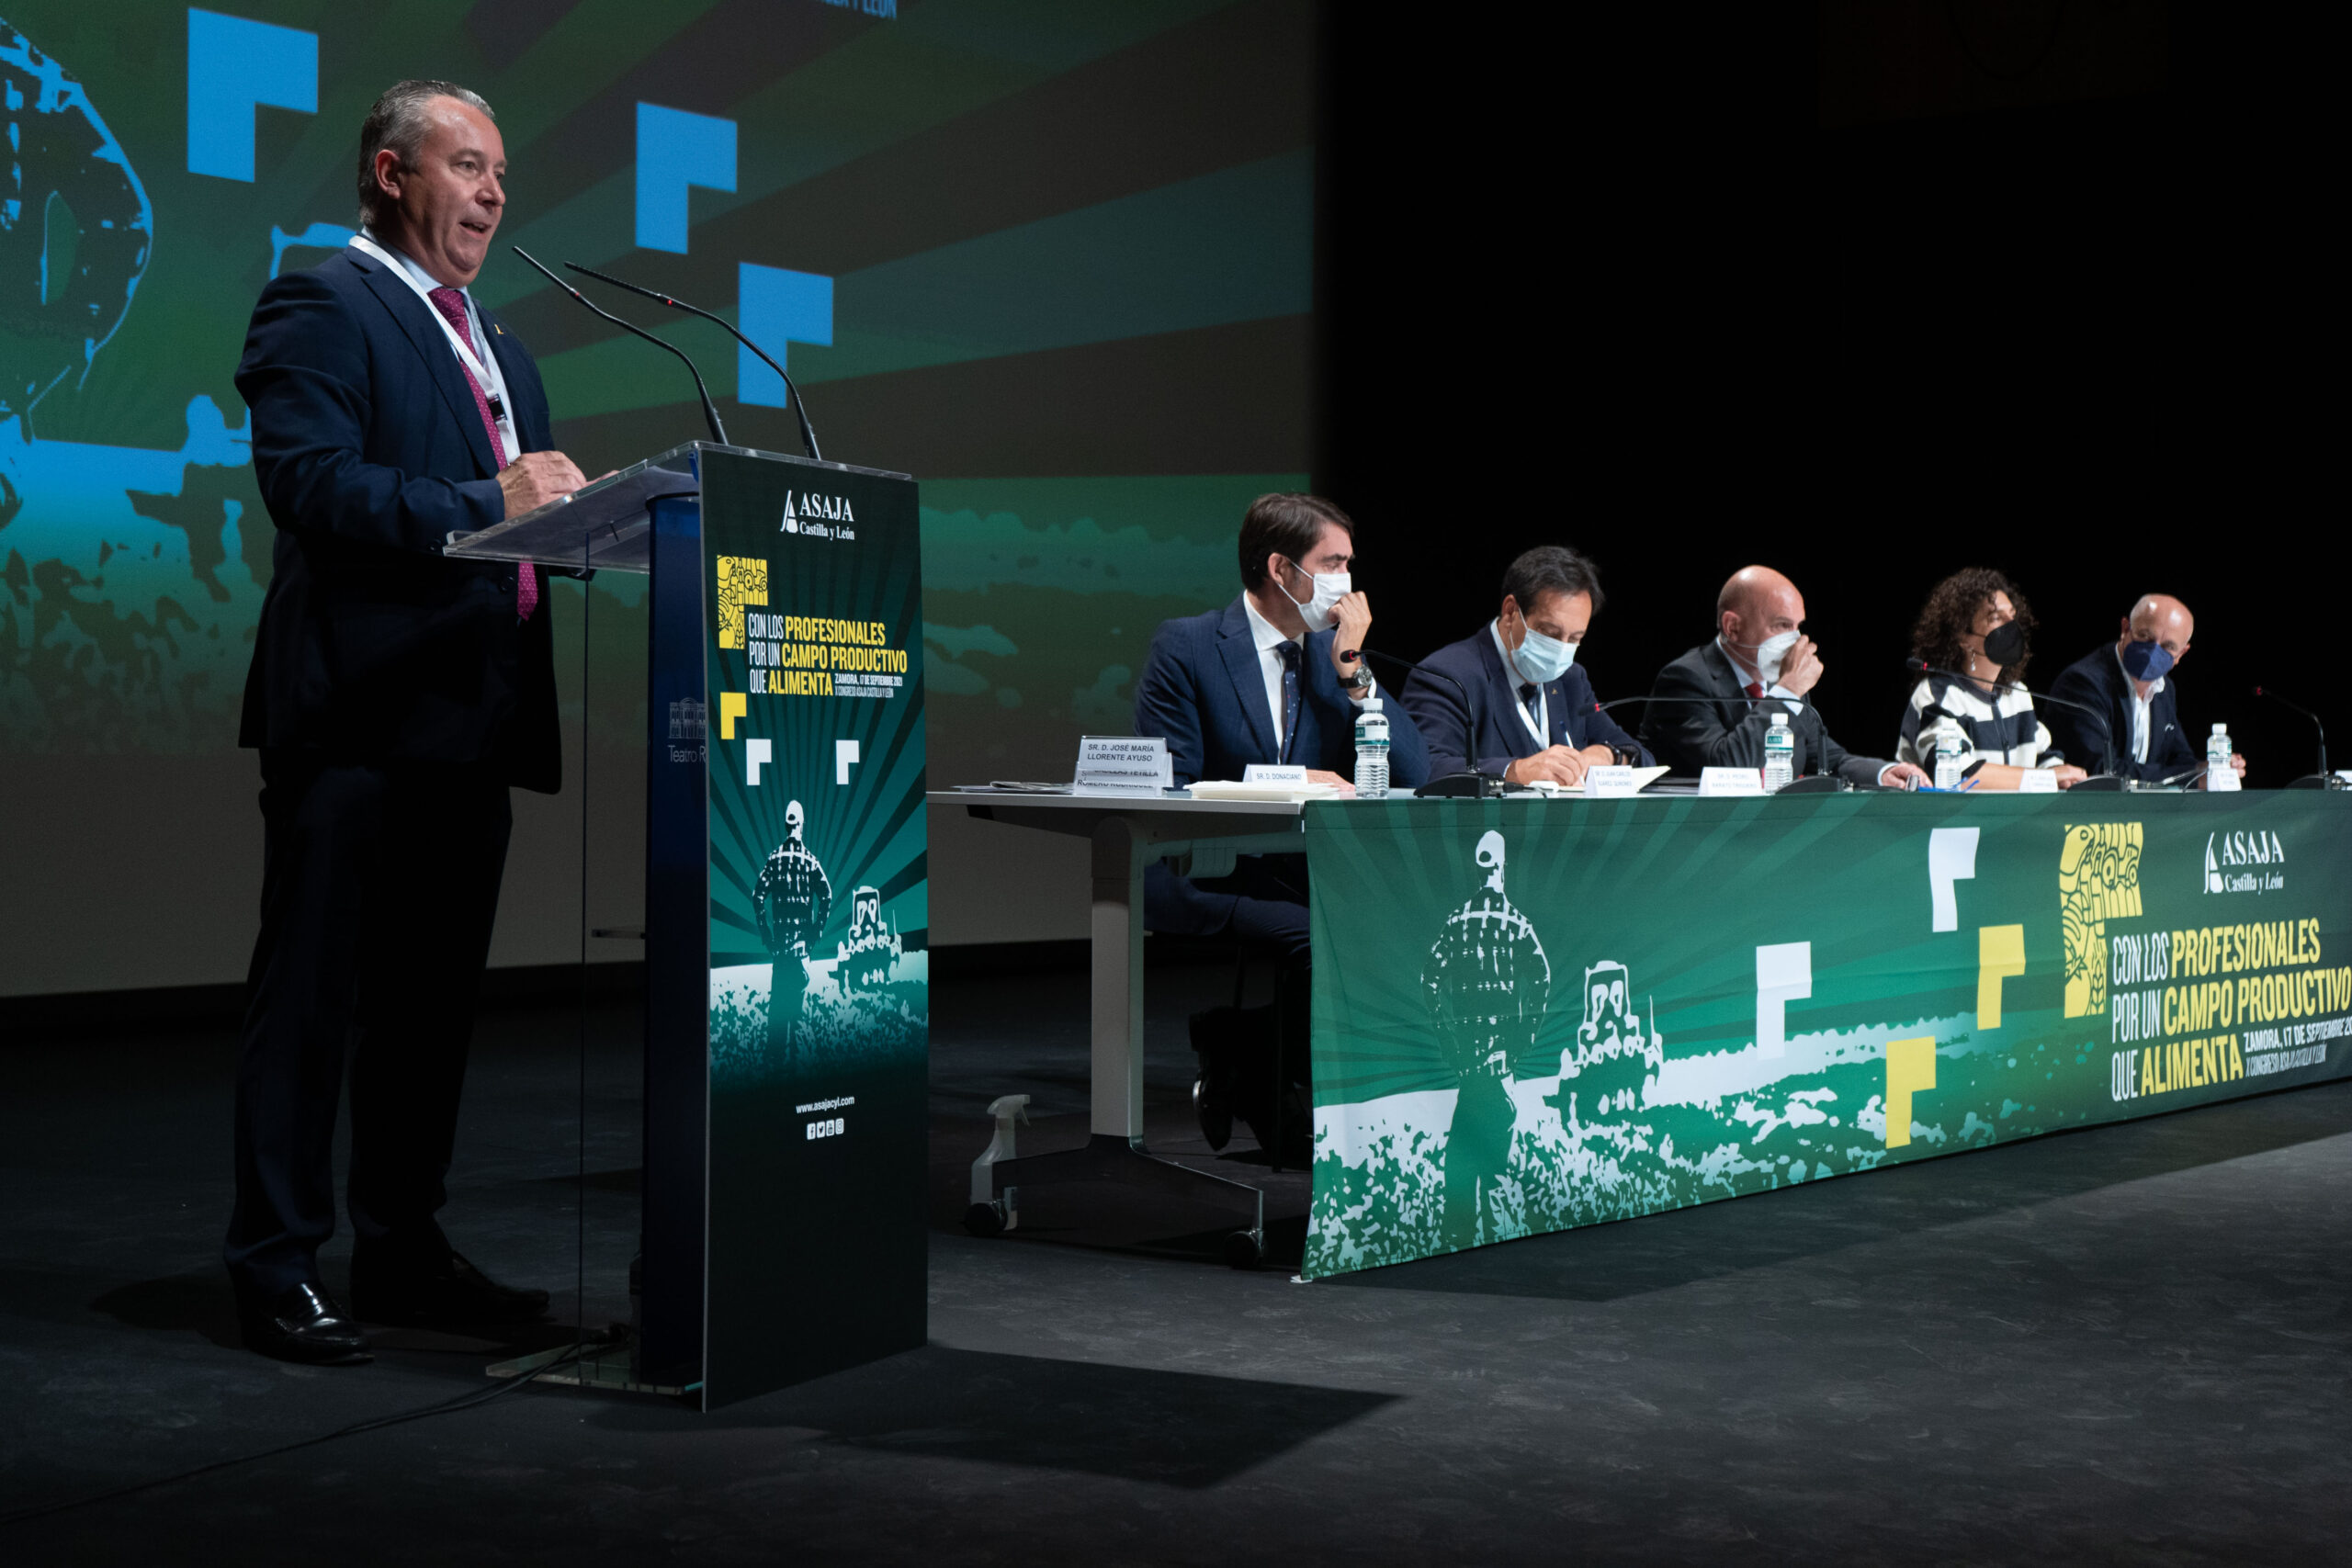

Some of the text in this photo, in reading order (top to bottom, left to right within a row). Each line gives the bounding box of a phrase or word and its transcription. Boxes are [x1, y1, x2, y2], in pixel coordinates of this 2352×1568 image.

[800, 492, 854, 522] ASAJA
[799, 521, 854, 540] Castilla y León
[748, 613, 886, 646] CON LOS PROFESIONALES
[749, 641, 908, 673] POR UN CAMPO PRODUCTIVO
[750, 669, 833, 696] QUE ALIMENTA
[834, 673, 859, 685] ZAMORA,
[666, 744, 698, 763] Teatro
[1087, 753, 1125, 761] LLORENTE
[1110, 743, 1128, 751] JOSÉ
[1131, 744, 1155, 752] MARÍA
[2222, 830, 2285, 865] ASAJA
[2224, 871, 2284, 896] Castilla y León
[2112, 917, 2321, 987] CON LOS PROFESIONALES
[2112, 966, 2352, 1044] POR UN CAMPO PRODUCTIVO
[2243, 1028, 2283, 1053] ZAMORA,
[2283, 1026, 2292, 1047] 17
[2293, 1024, 2306, 1045] DE
[2306, 1017, 2345, 1043] SEPTIEMBRE
[2111, 1033, 2245, 1102] QUE ALIMENTA
[796, 1096, 854, 1113] www.asajacyl.com
